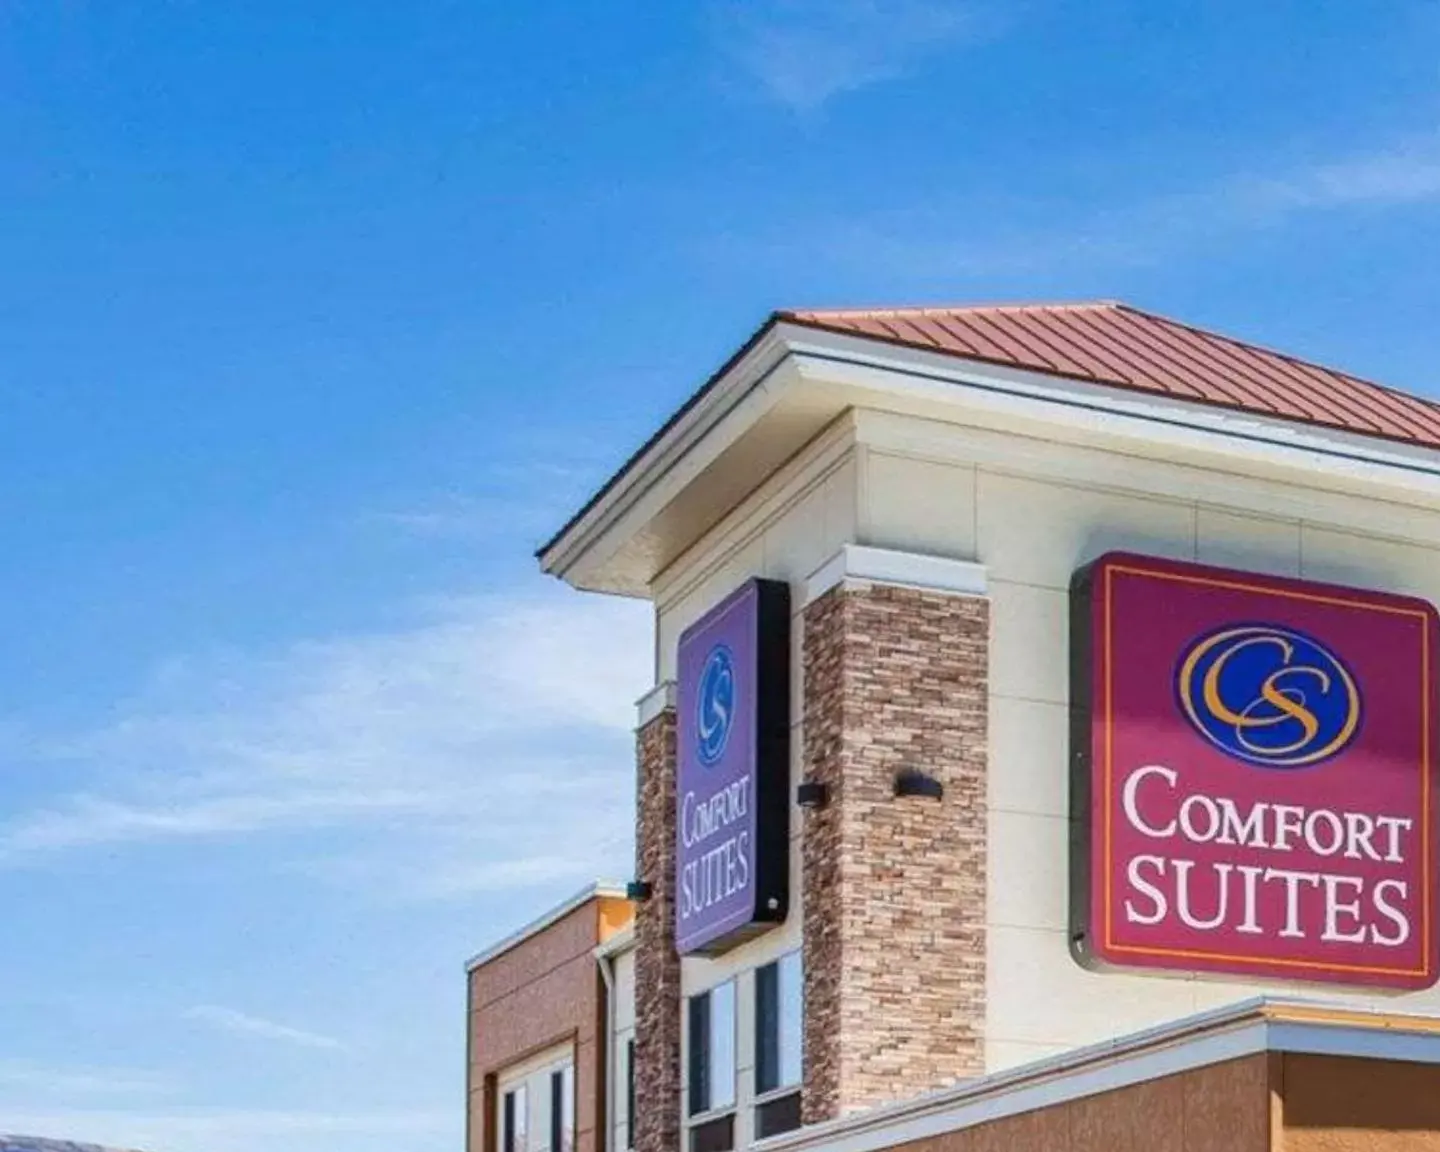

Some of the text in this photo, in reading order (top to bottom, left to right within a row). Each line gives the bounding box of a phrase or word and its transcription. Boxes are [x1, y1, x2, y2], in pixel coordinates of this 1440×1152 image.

[681, 774, 750, 849] COMFORT
[1122, 765, 1412, 864] COMFORT
[682, 831, 748, 919] SUITES
[1125, 854, 1410, 947] SUITES
